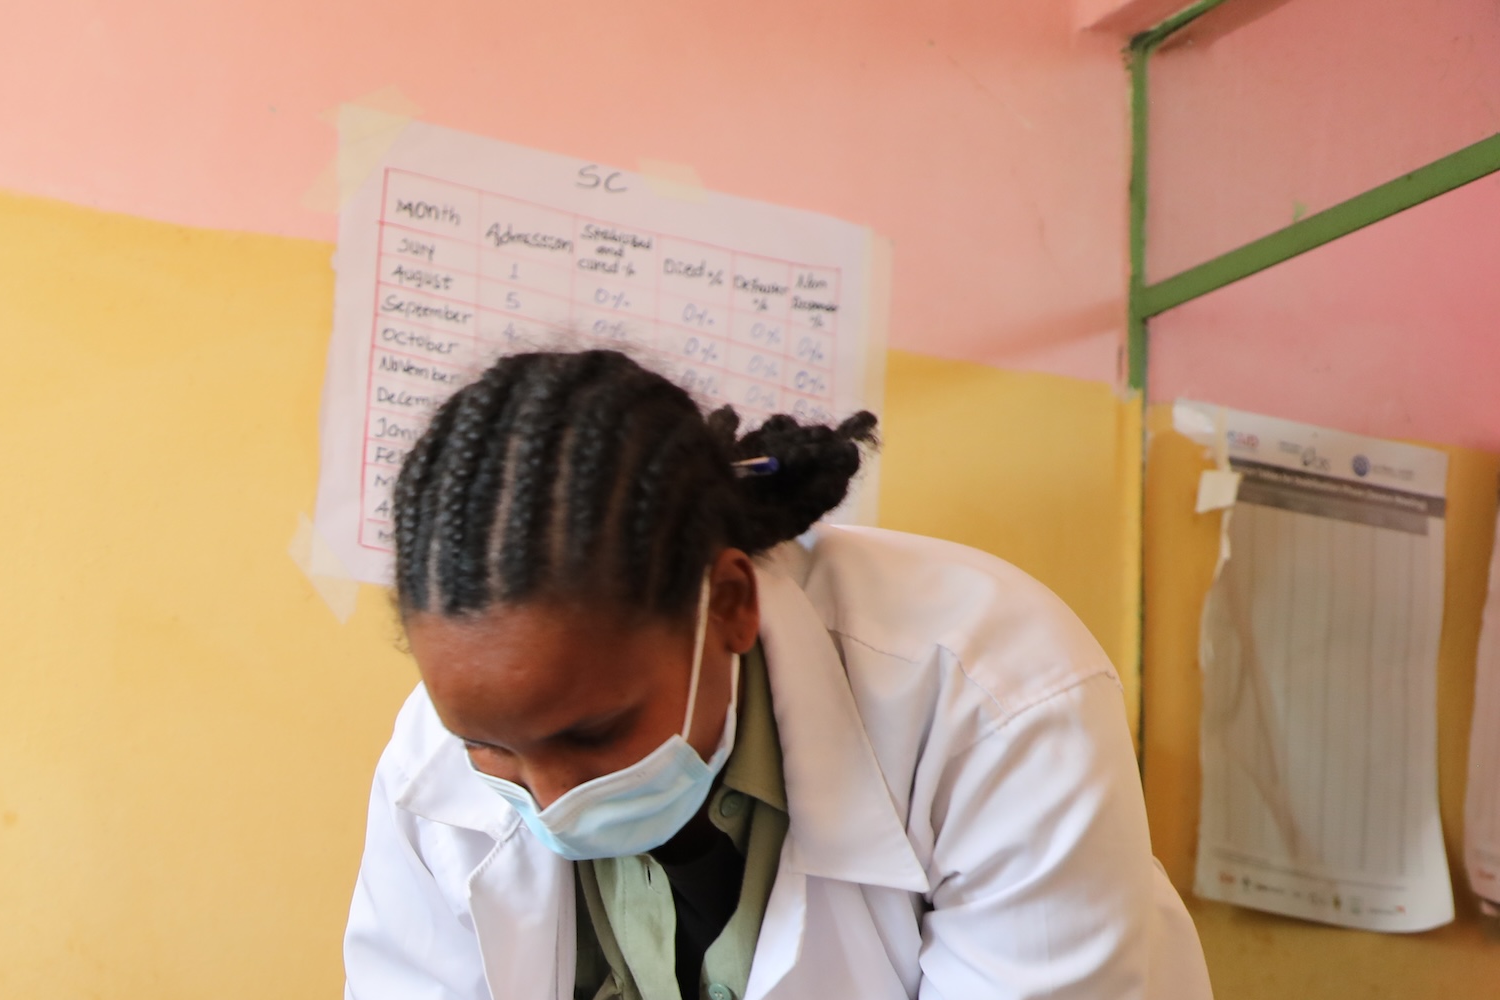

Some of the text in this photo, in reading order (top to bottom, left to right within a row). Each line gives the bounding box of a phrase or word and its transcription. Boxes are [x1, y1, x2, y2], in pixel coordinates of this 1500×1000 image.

[573, 164, 629, 194] SC
[509, 262, 520, 280] 1
[391, 264, 454, 290] August
[505, 291, 521, 310] 5
[380, 294, 473, 324] September
[382, 327, 459, 354] October
